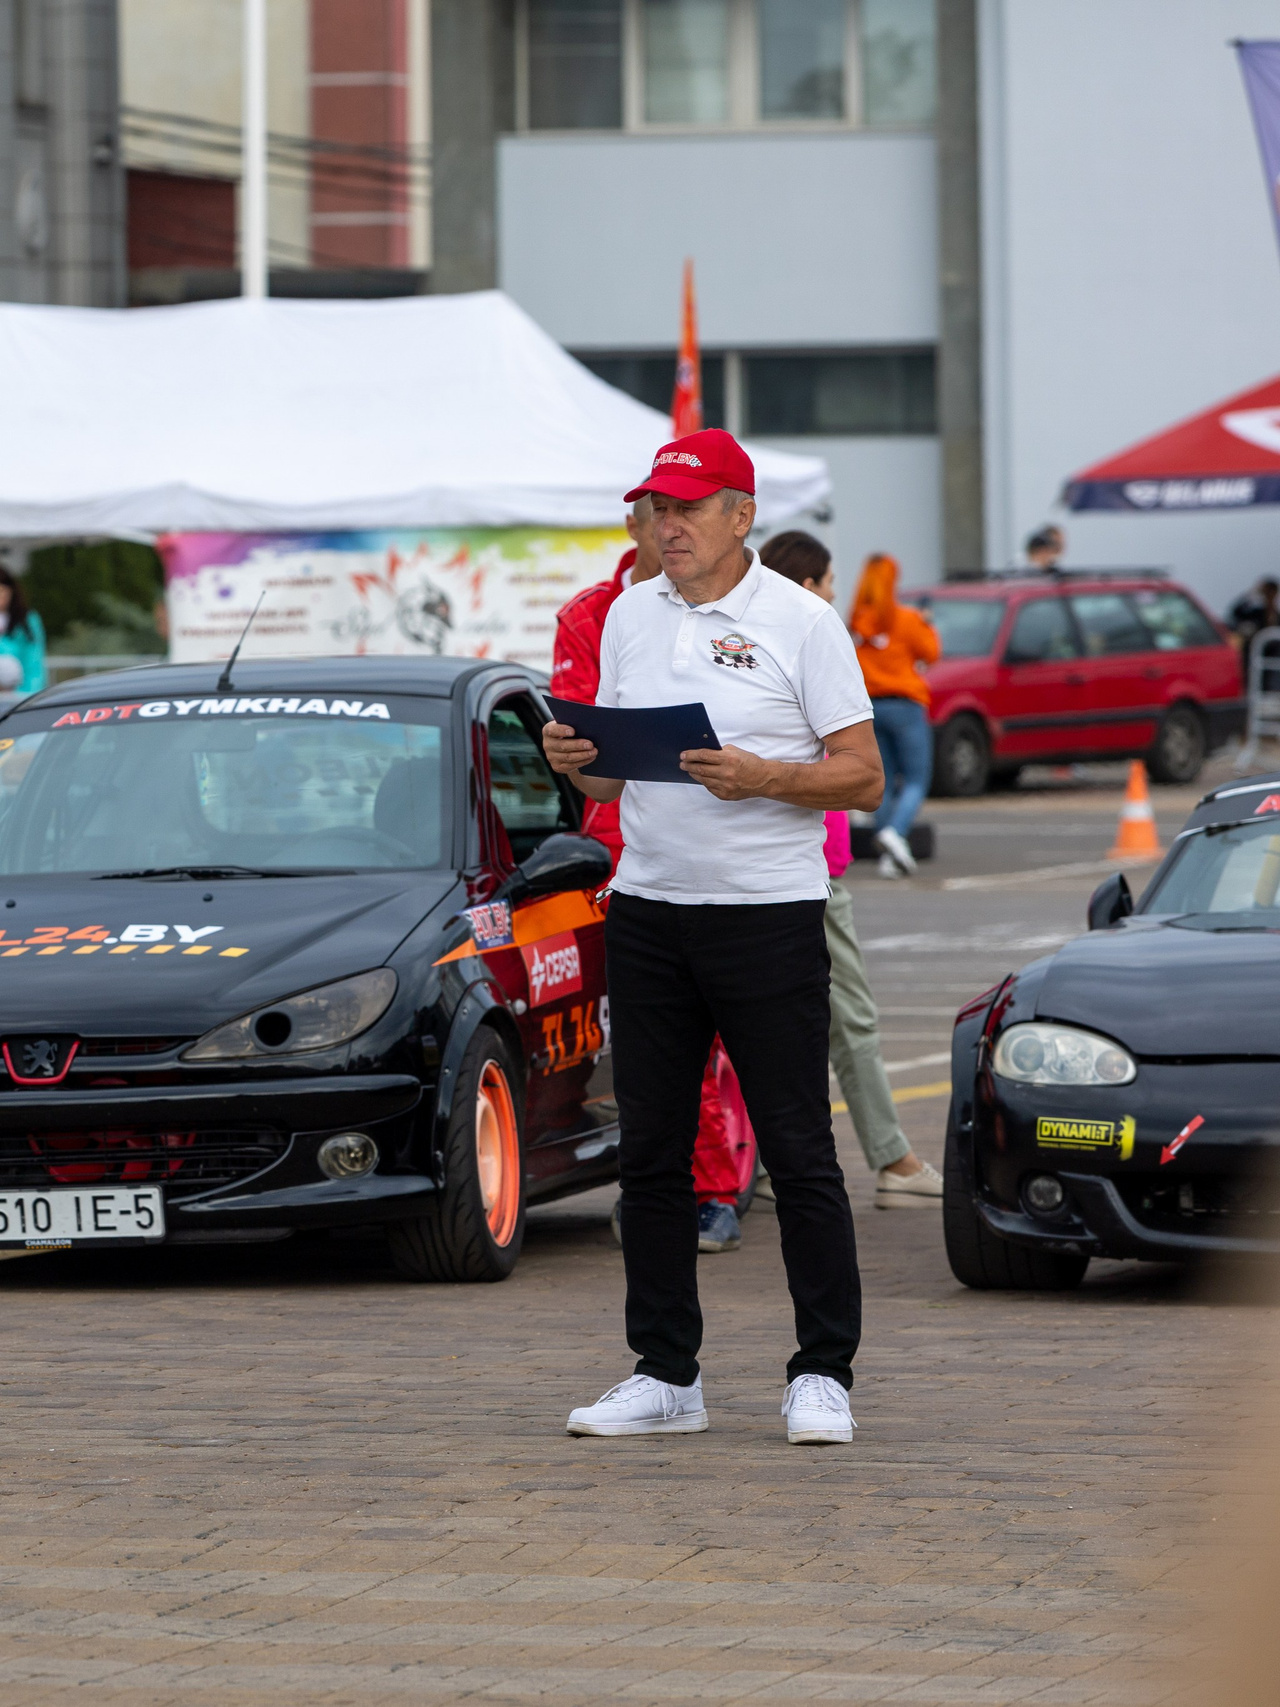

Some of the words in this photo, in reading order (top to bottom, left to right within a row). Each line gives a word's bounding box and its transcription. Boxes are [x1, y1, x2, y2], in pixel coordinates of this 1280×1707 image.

[52, 698, 391, 728] ADTGYMKHANA
[469, 901, 508, 942] ADT.BY
[544, 945, 580, 986] CEPSA
[74, 1193, 154, 1232] IE-5
